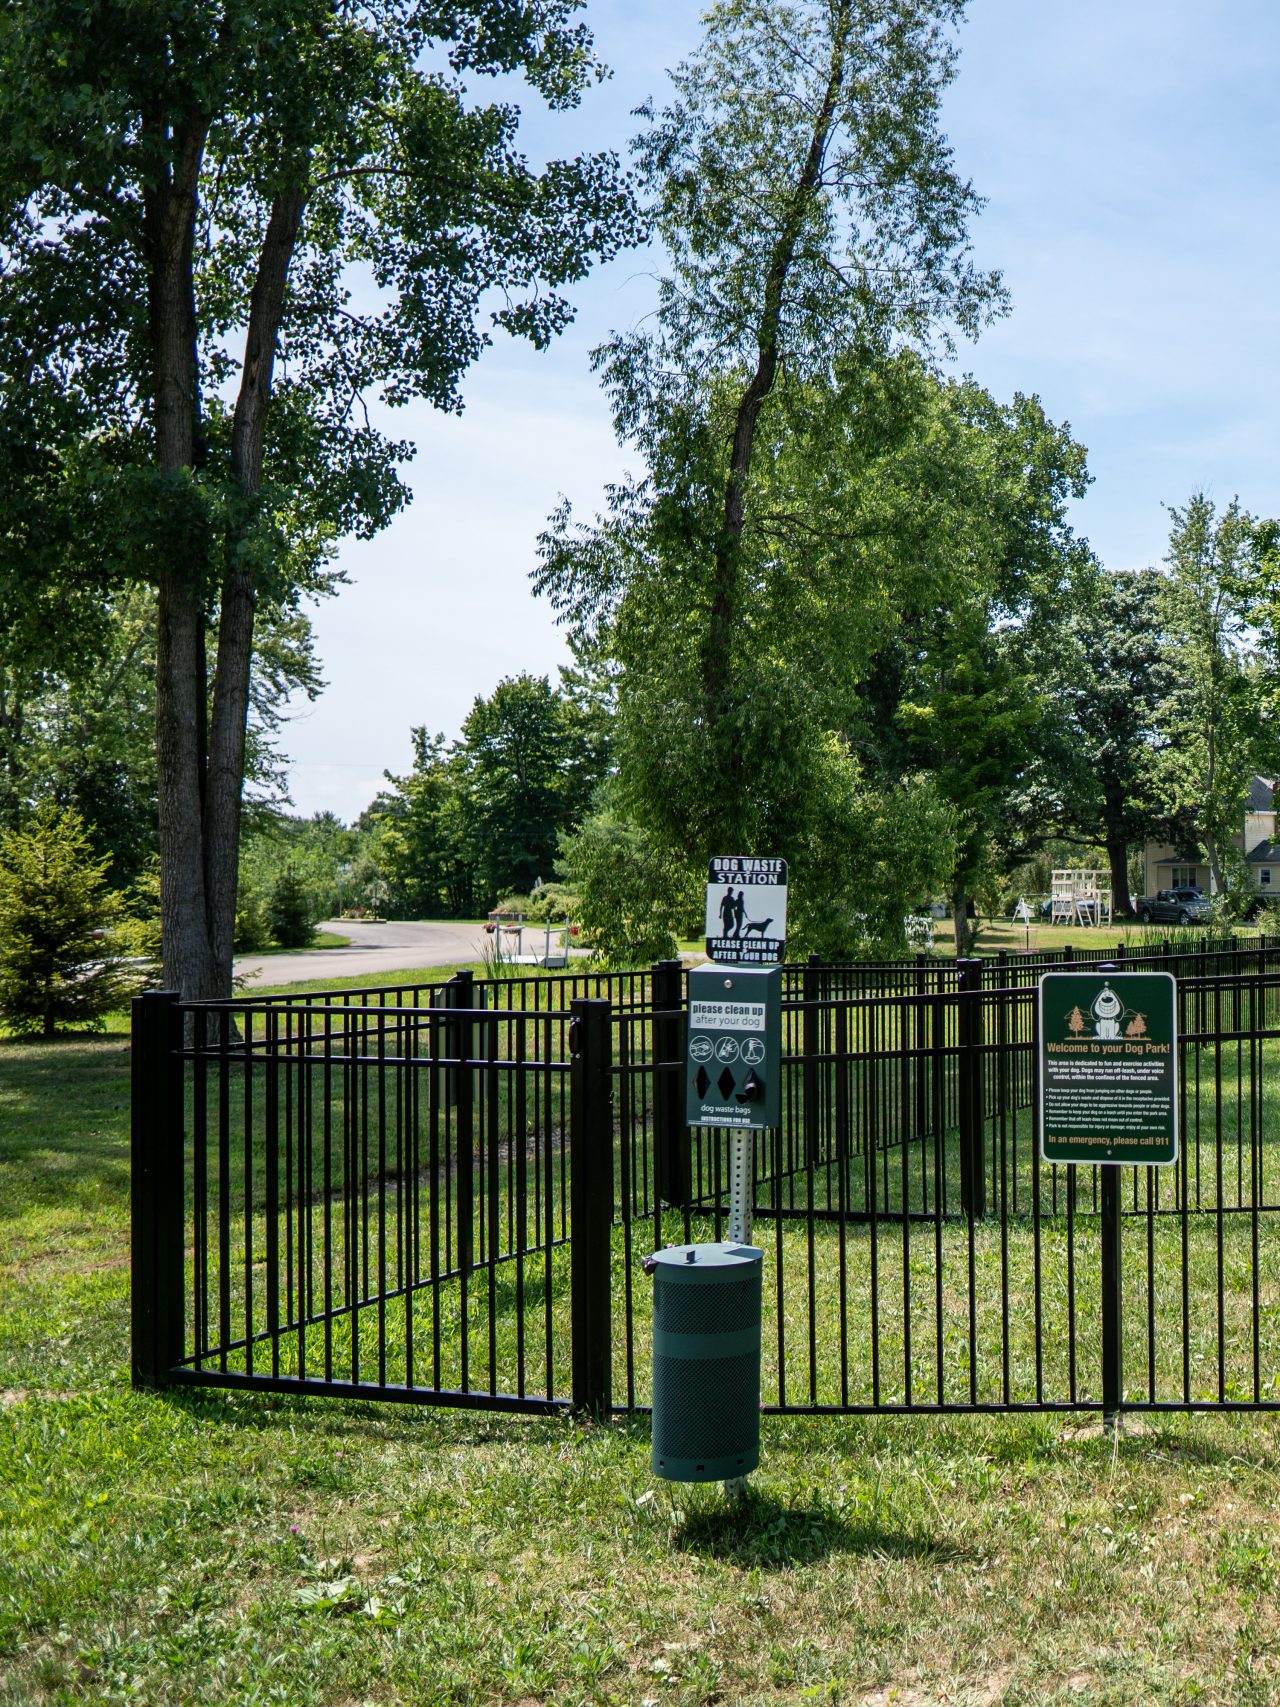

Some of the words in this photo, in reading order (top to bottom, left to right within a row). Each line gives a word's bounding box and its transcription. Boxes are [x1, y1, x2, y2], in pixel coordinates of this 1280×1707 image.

[714, 859, 738, 871] DOG
[742, 859, 782, 872] WASTE
[718, 873, 777, 884] STATION
[712, 940, 740, 949] PLEASE
[742, 940, 766, 949] CLEAN
[770, 941, 779, 950] UP
[713, 951, 737, 960] AFTER
[740, 952, 760, 960] YOUR
[762, 952, 778, 961] DOG
[693, 1004, 722, 1014] please
[725, 1005, 749, 1014] clean
[752, 1007, 763, 1016] up
[696, 1015, 716, 1024] after
[719, 1017, 741, 1026] your
[742, 1016, 760, 1028] dog
[1047, 1043, 1088, 1052] Welcome
[1091, 1043, 1100, 1053] to
[1103, 1045, 1123, 1055] your
[1125, 1043, 1143, 1055] Dog
[1146, 1043, 1170, 1053] Park!
[701, 1104, 714, 1113] dog
[735, 1106, 751, 1115] bags
[1069, 1137, 1112, 1146] emergency,
[1113, 1136, 1138, 1146] please
